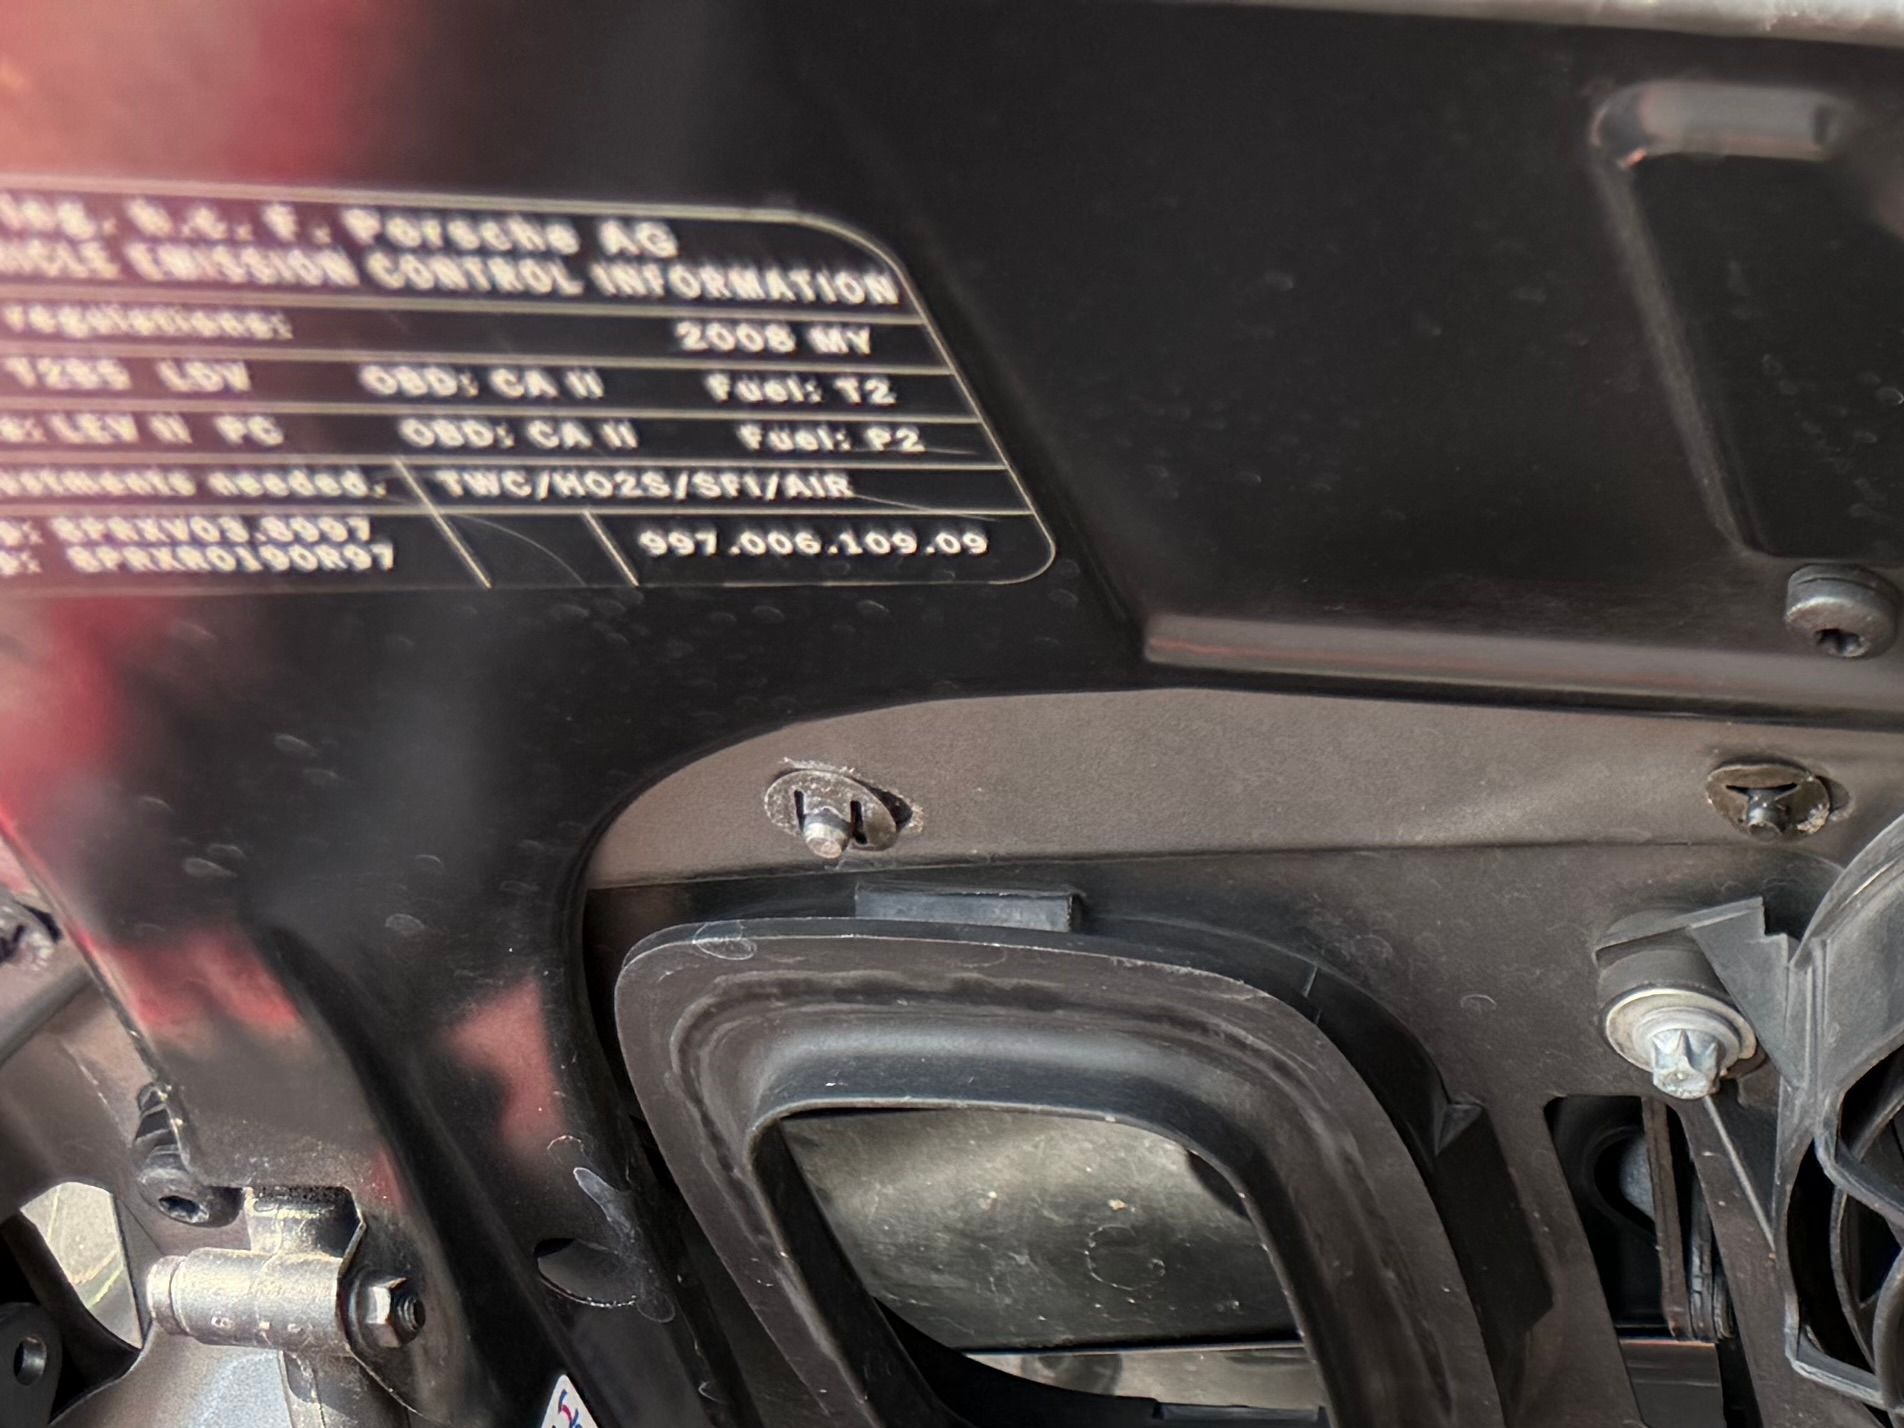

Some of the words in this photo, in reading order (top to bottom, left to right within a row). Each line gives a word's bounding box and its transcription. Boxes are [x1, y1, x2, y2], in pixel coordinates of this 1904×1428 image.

[342, 207, 580, 256] Porsche
[600, 218, 678, 259] AG
[125, 242, 360, 287] EMISSION
[364, 250, 584, 296] CONTROL
[590, 258, 899, 305] INFORMATION
[674, 320, 797, 354] 2008
[807, 325, 873, 356] MY
[359, 363, 479, 398] OBD:
[489, 367, 560, 399] CA
[704, 372, 823, 405] Fuel:
[832, 377, 898, 406] T2
[400, 417, 516, 450] OBD:
[526, 419, 594, 450] CA
[736, 423, 851, 453] Fuel:
[207, 470, 387, 499] needed.
